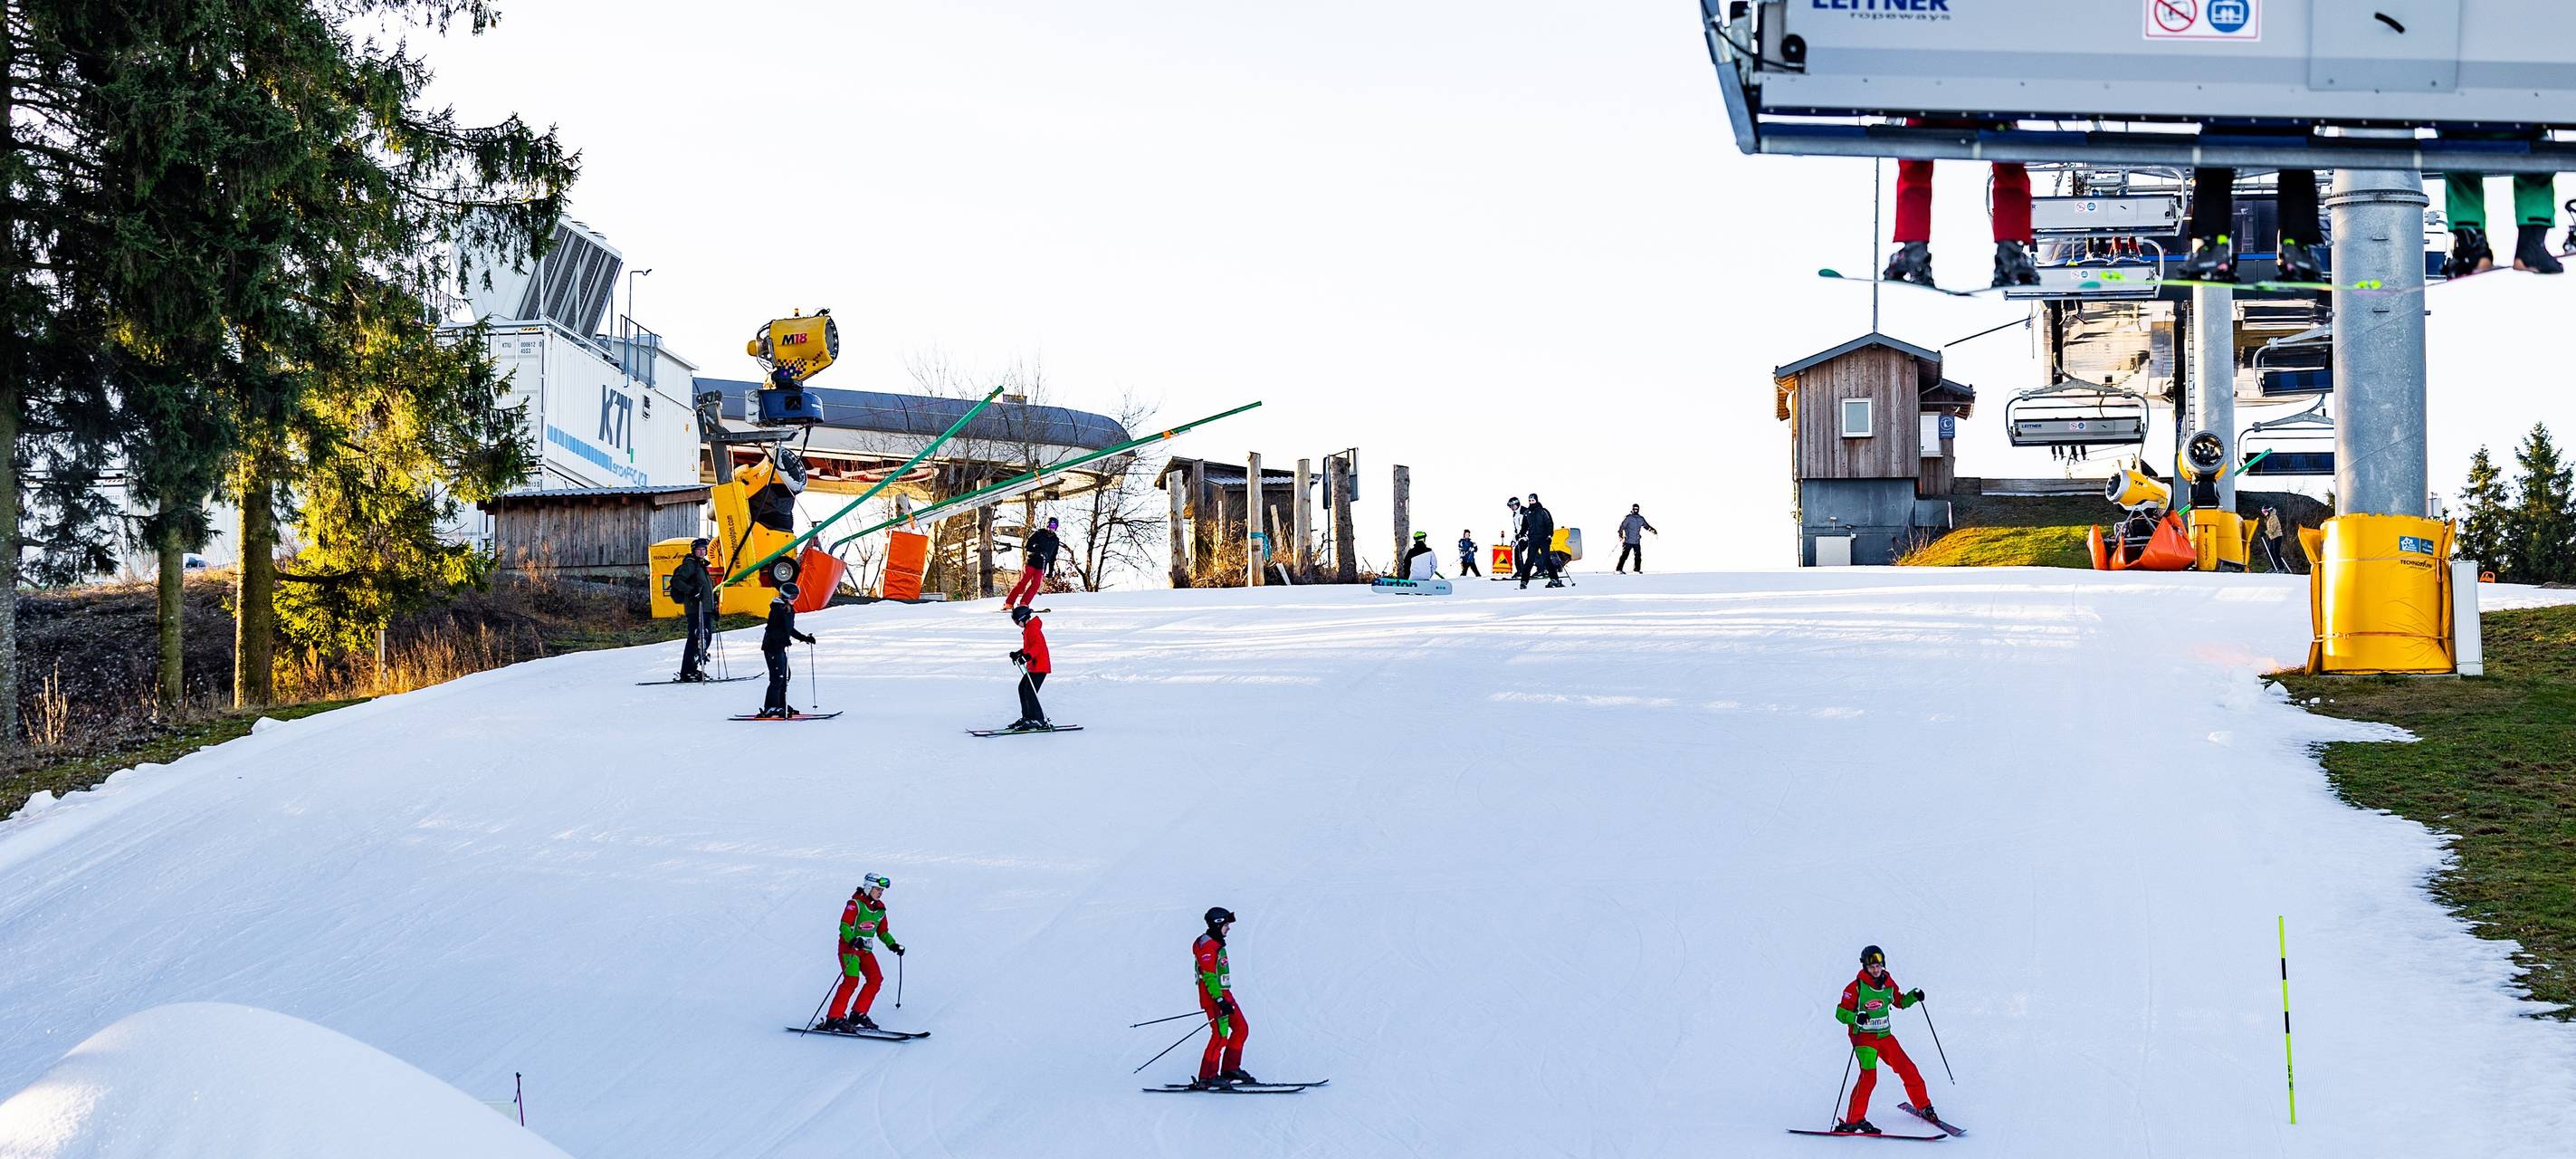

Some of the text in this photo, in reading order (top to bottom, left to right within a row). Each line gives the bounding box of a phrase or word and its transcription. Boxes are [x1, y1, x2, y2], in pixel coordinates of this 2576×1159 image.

[1812, 0, 1949, 12] LEITNER
[1851, 13, 1951, 22] ropeways
[782, 332, 807, 346] M18
[598, 384, 634, 455] KTI
